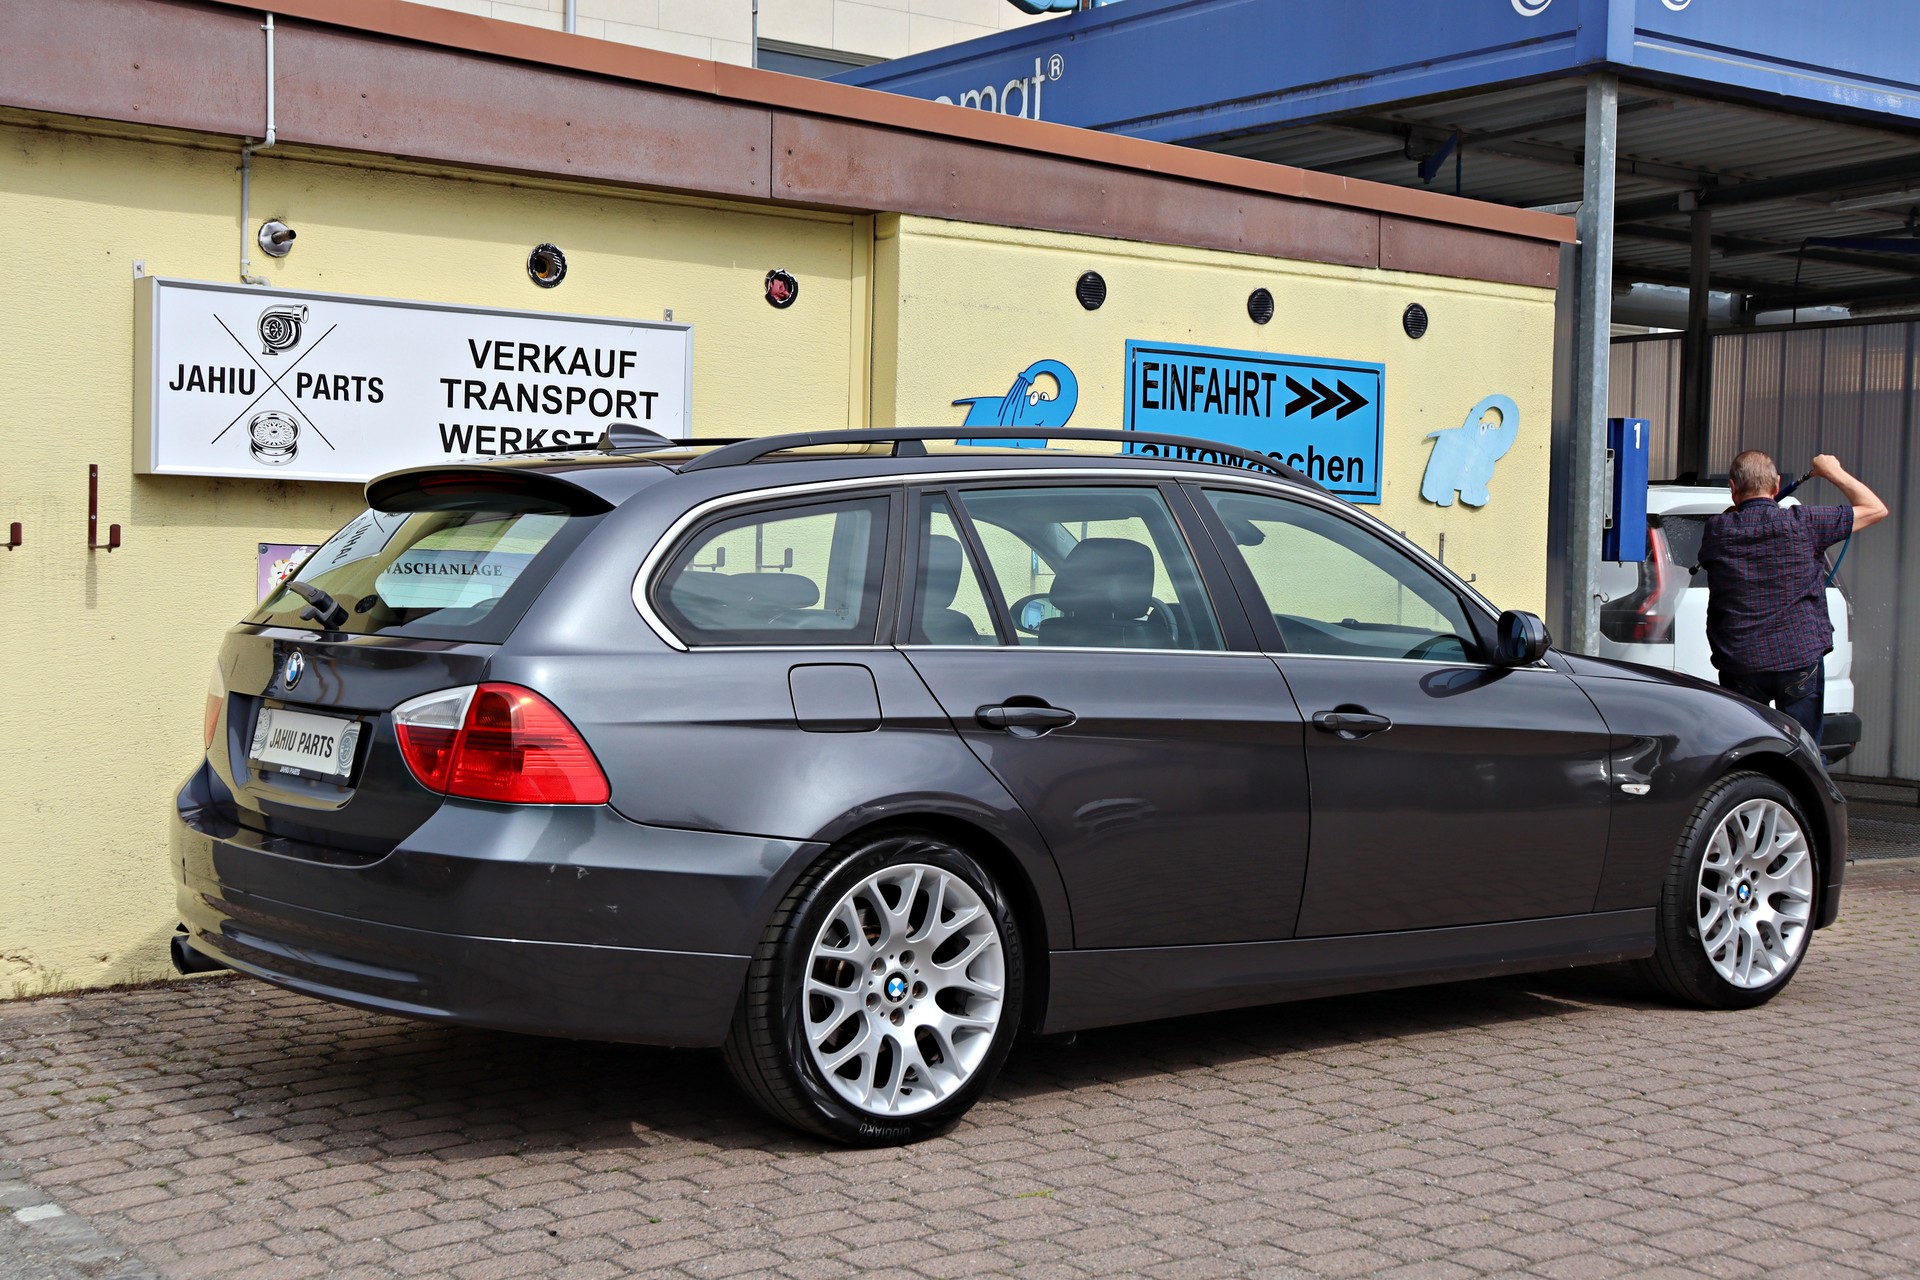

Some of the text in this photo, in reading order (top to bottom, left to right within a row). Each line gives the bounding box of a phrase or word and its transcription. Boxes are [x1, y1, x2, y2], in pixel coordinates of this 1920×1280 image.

[468, 338, 637, 378] VERKAUF
[169, 363, 384, 403] JAHIU PARTS
[439, 378, 658, 420] TRANSPORT
[1142, 362, 1276, 418] EINFAHRT
[438, 423, 606, 456] WERKST
[1634, 423, 1641, 449] 1
[270, 728, 334, 758] JAHIU PARTS
